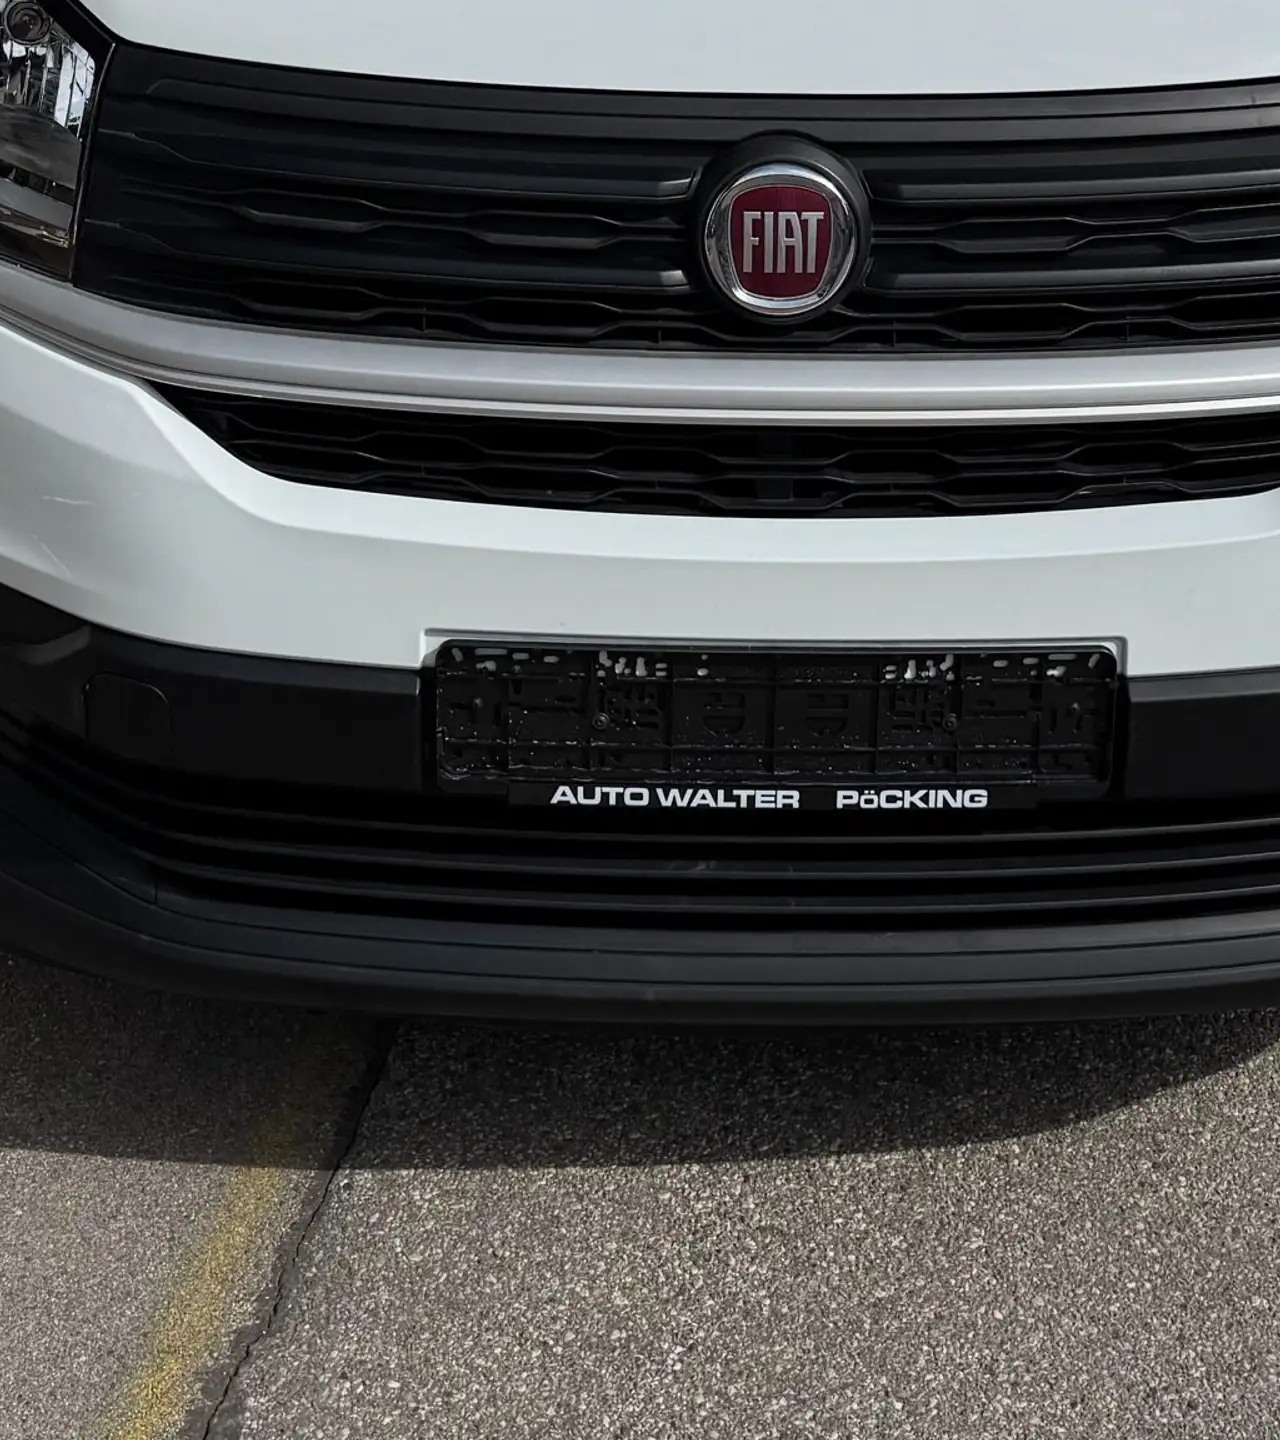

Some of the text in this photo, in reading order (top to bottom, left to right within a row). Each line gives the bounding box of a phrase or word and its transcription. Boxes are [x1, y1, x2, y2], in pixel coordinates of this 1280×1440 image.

[742, 211, 825, 274] FIAT
[550, 785, 650, 808] AUTO
[655, 786, 801, 809] WALTER
